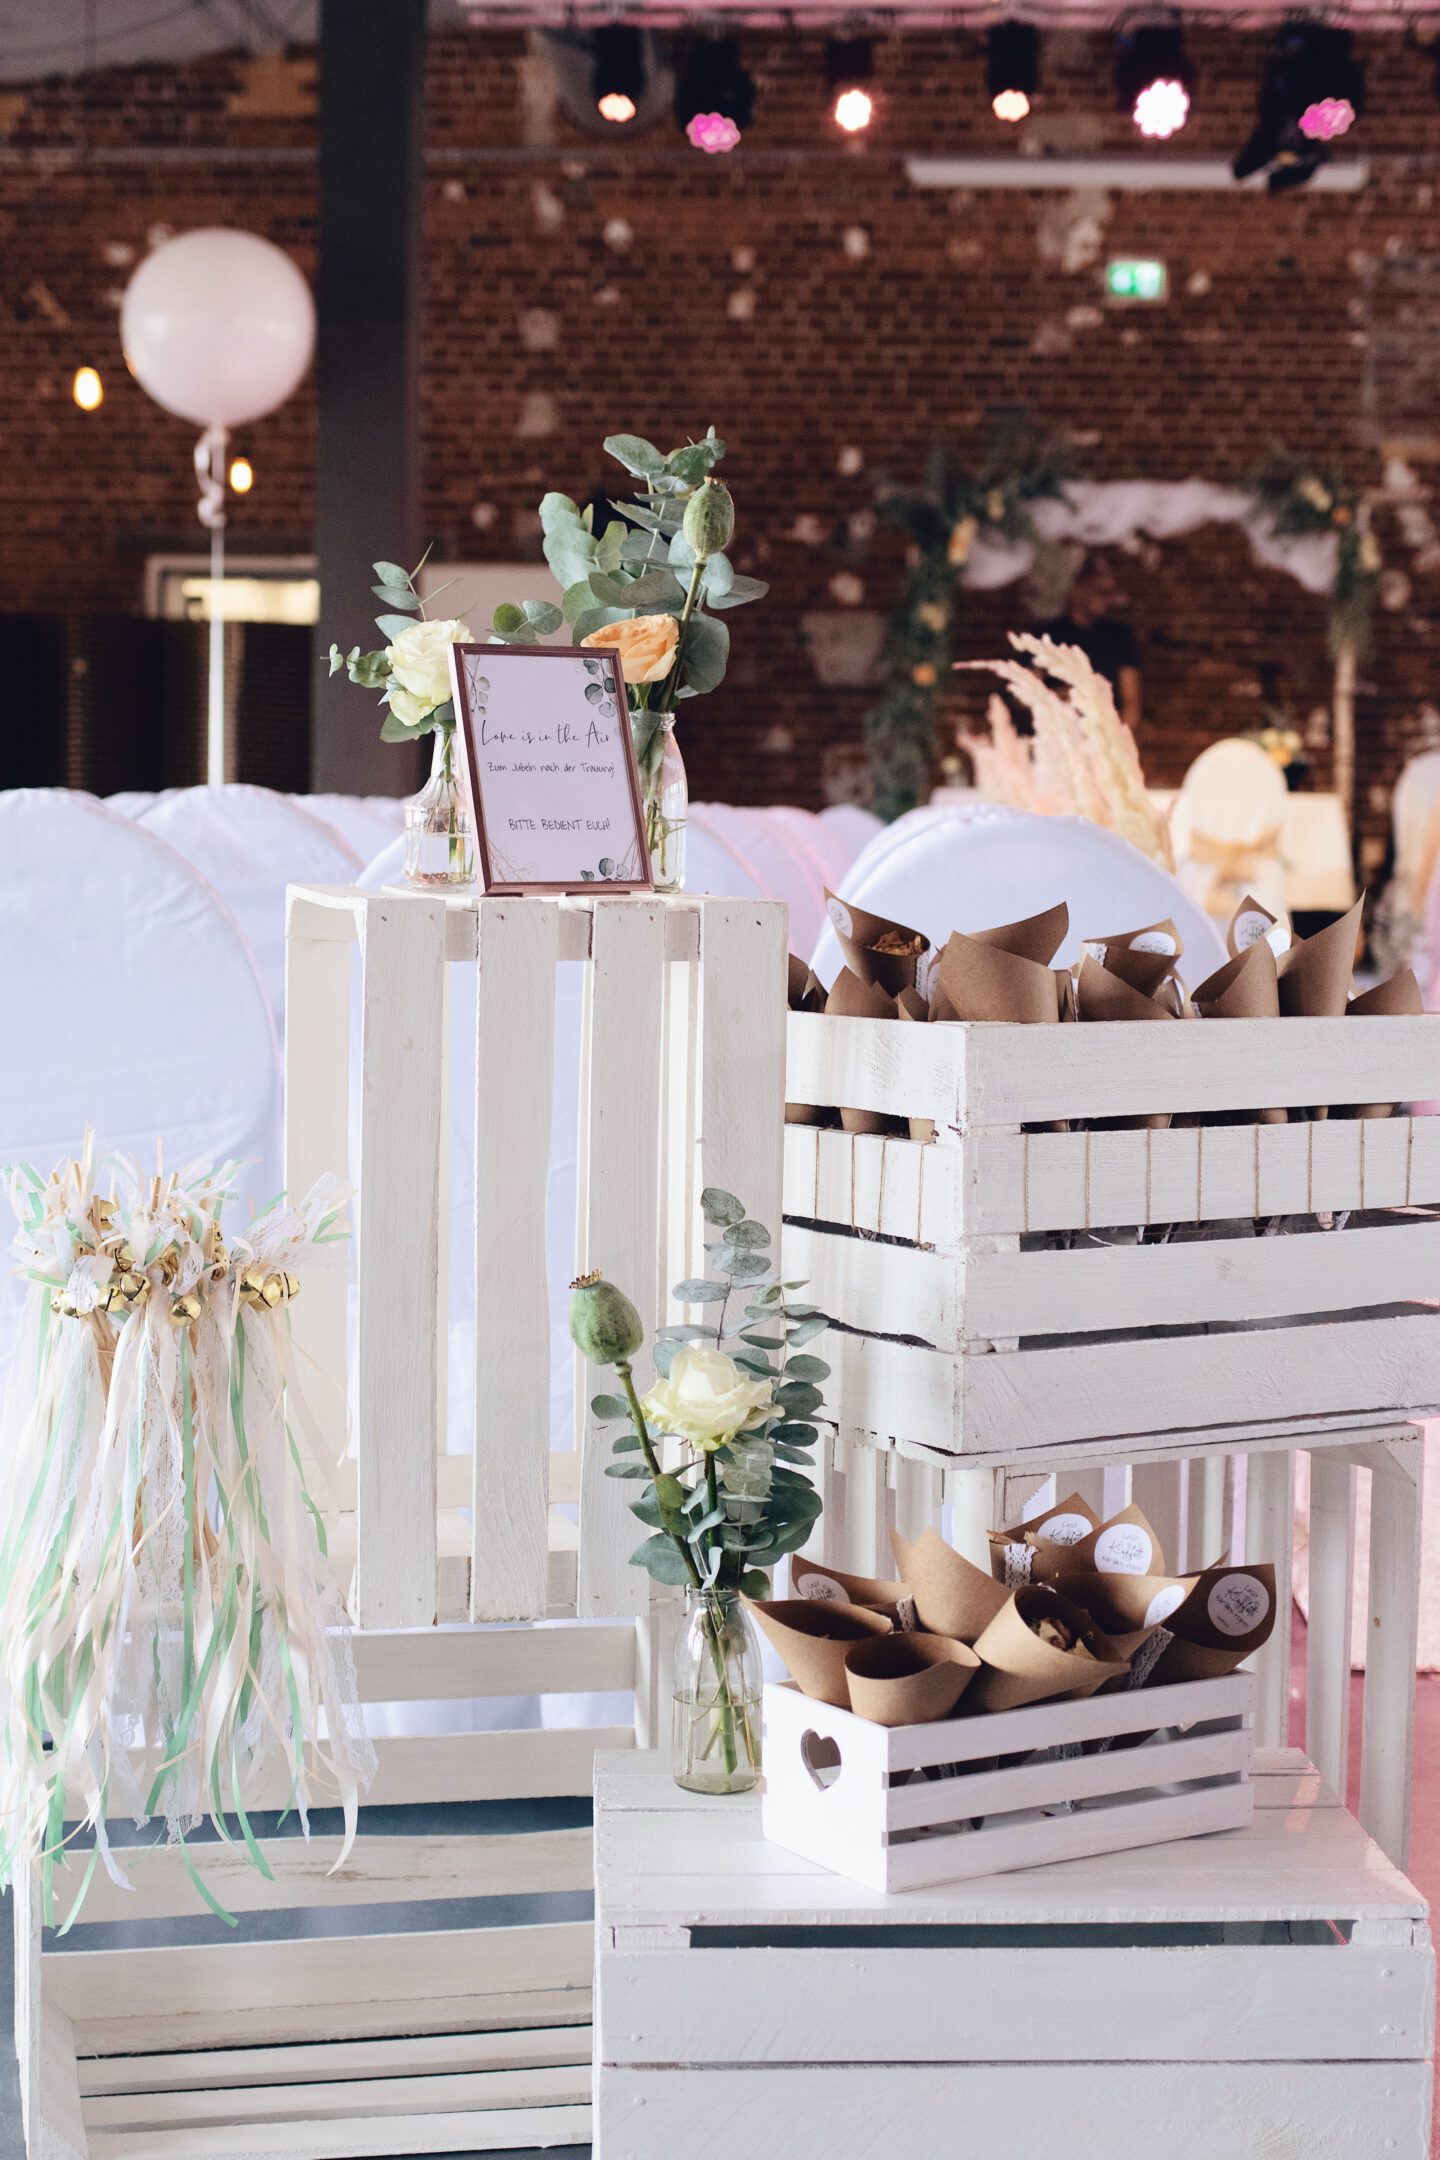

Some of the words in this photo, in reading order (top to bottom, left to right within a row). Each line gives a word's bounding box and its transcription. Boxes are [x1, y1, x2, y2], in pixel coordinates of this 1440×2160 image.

[481, 719, 517, 746] Love
[522, 730, 534, 744] is
[538, 730, 553, 742] in
[555, 723, 581, 744] the
[585, 720, 610, 748] Air
[487, 761, 507, 772] Zum
[511, 761, 537, 772] Jubeln
[540, 762, 560, 772] nach
[563, 762, 576, 773] der
[580, 761, 615, 778] Trauung!
[508, 818, 537, 831] BITTE
[541, 818, 583, 831] BEDIENT
[586, 817, 610, 831] EUCH!
